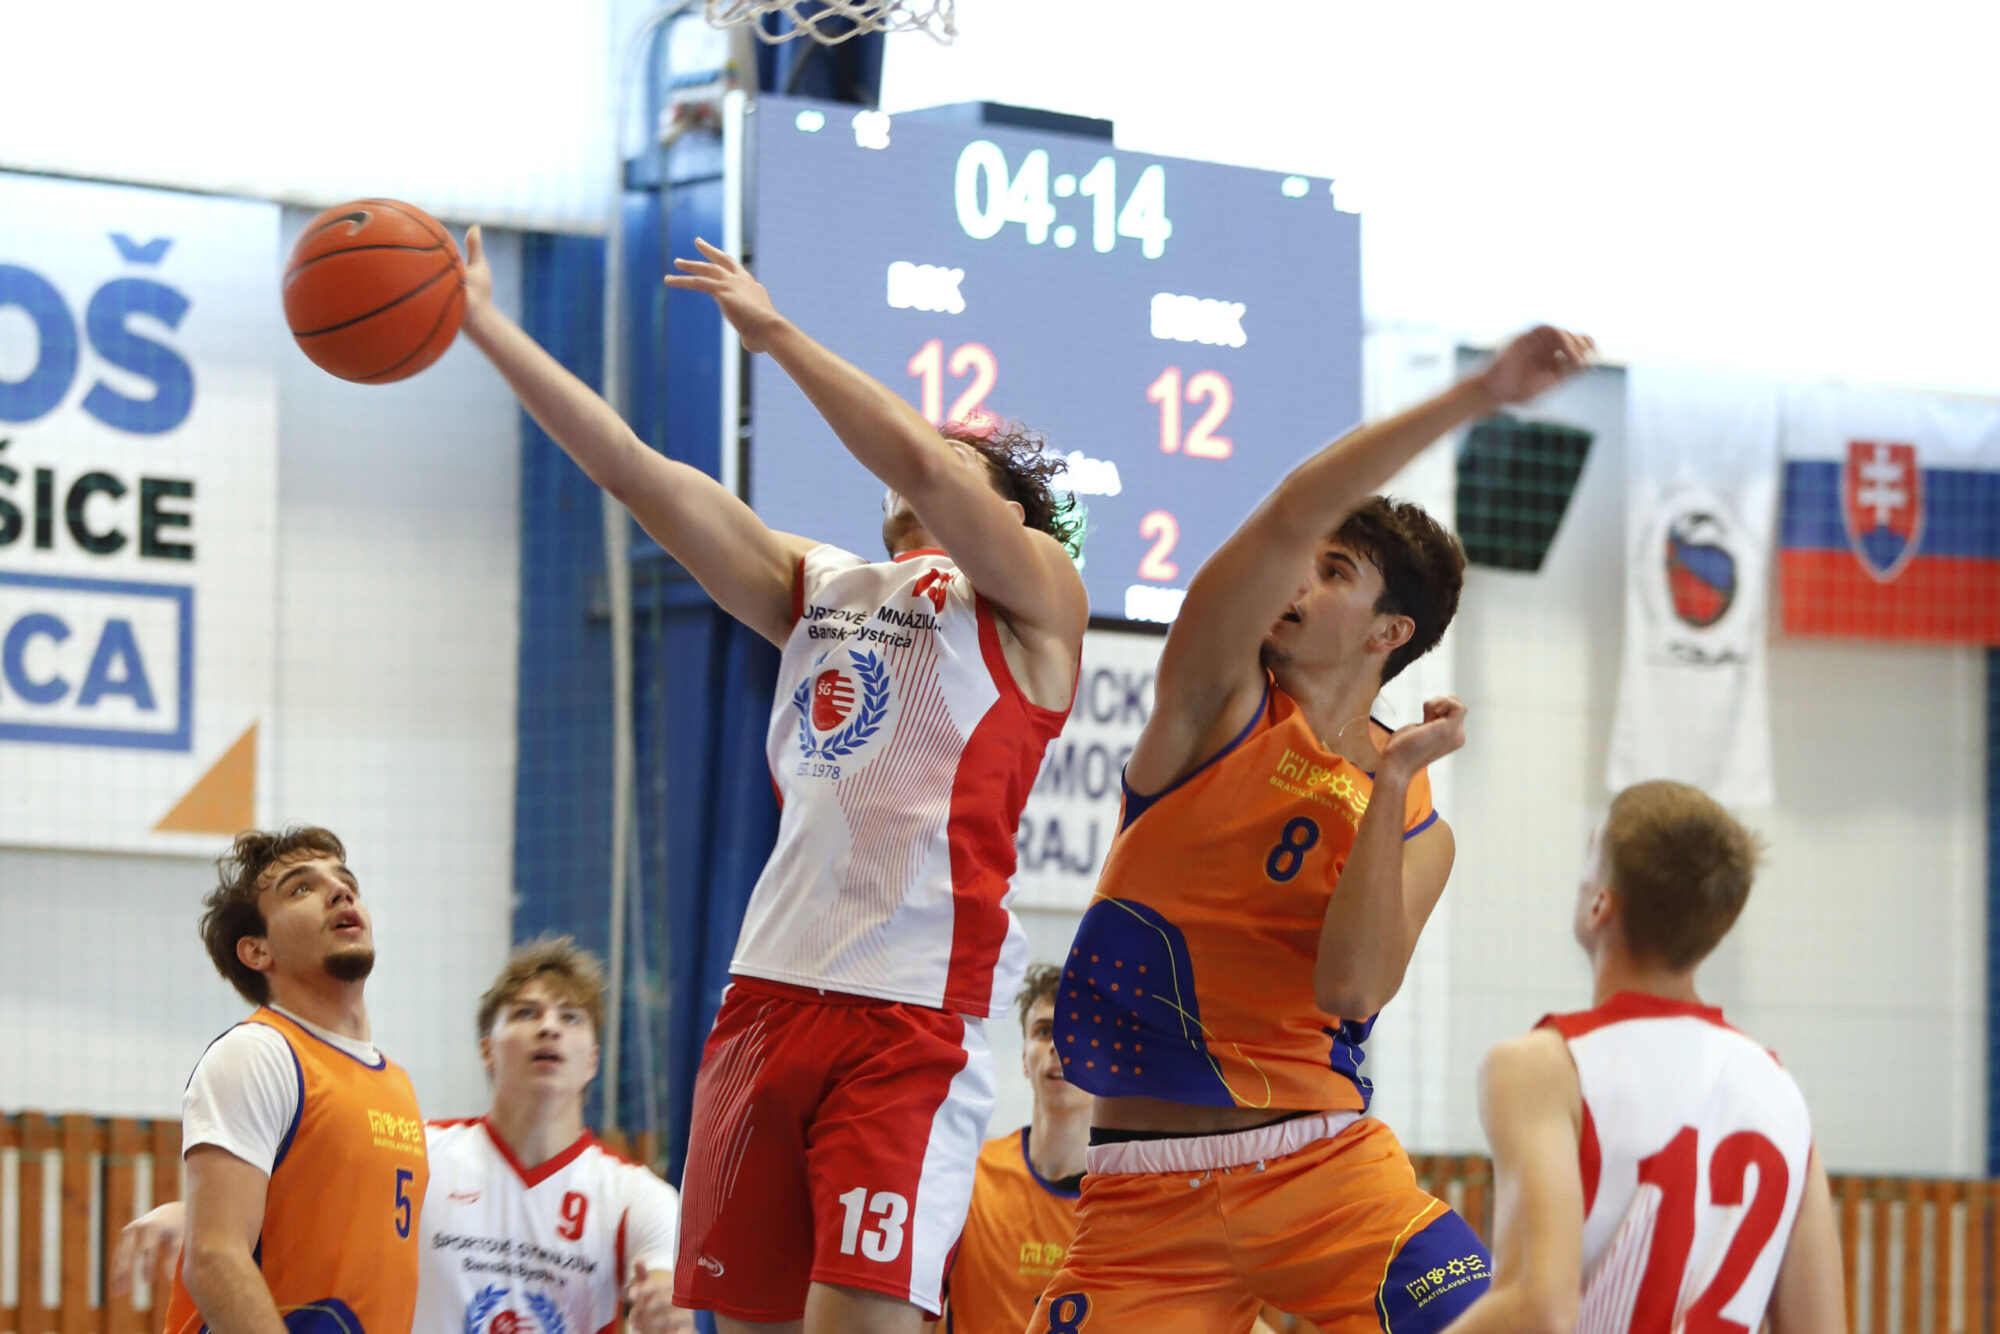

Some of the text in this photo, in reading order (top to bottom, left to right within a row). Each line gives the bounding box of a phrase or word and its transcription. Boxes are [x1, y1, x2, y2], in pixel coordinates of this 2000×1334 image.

[955, 140, 1172, 258] 04:14
[907, 339, 999, 437] 12
[1146, 366, 1233, 460] 12
[1138, 510, 1180, 582] 2
[808, 625, 854, 641] Bansk
[811, 763, 841, 780] 1978
[1266, 816, 1320, 883] 8
[395, 1167, 413, 1239] 5
[556, 1191, 588, 1241] 9
[839, 1186, 909, 1262] 13
[1626, 1124, 1790, 1334] 12
[1418, 1275, 1472, 1308] BRATISLAVSKÝ
